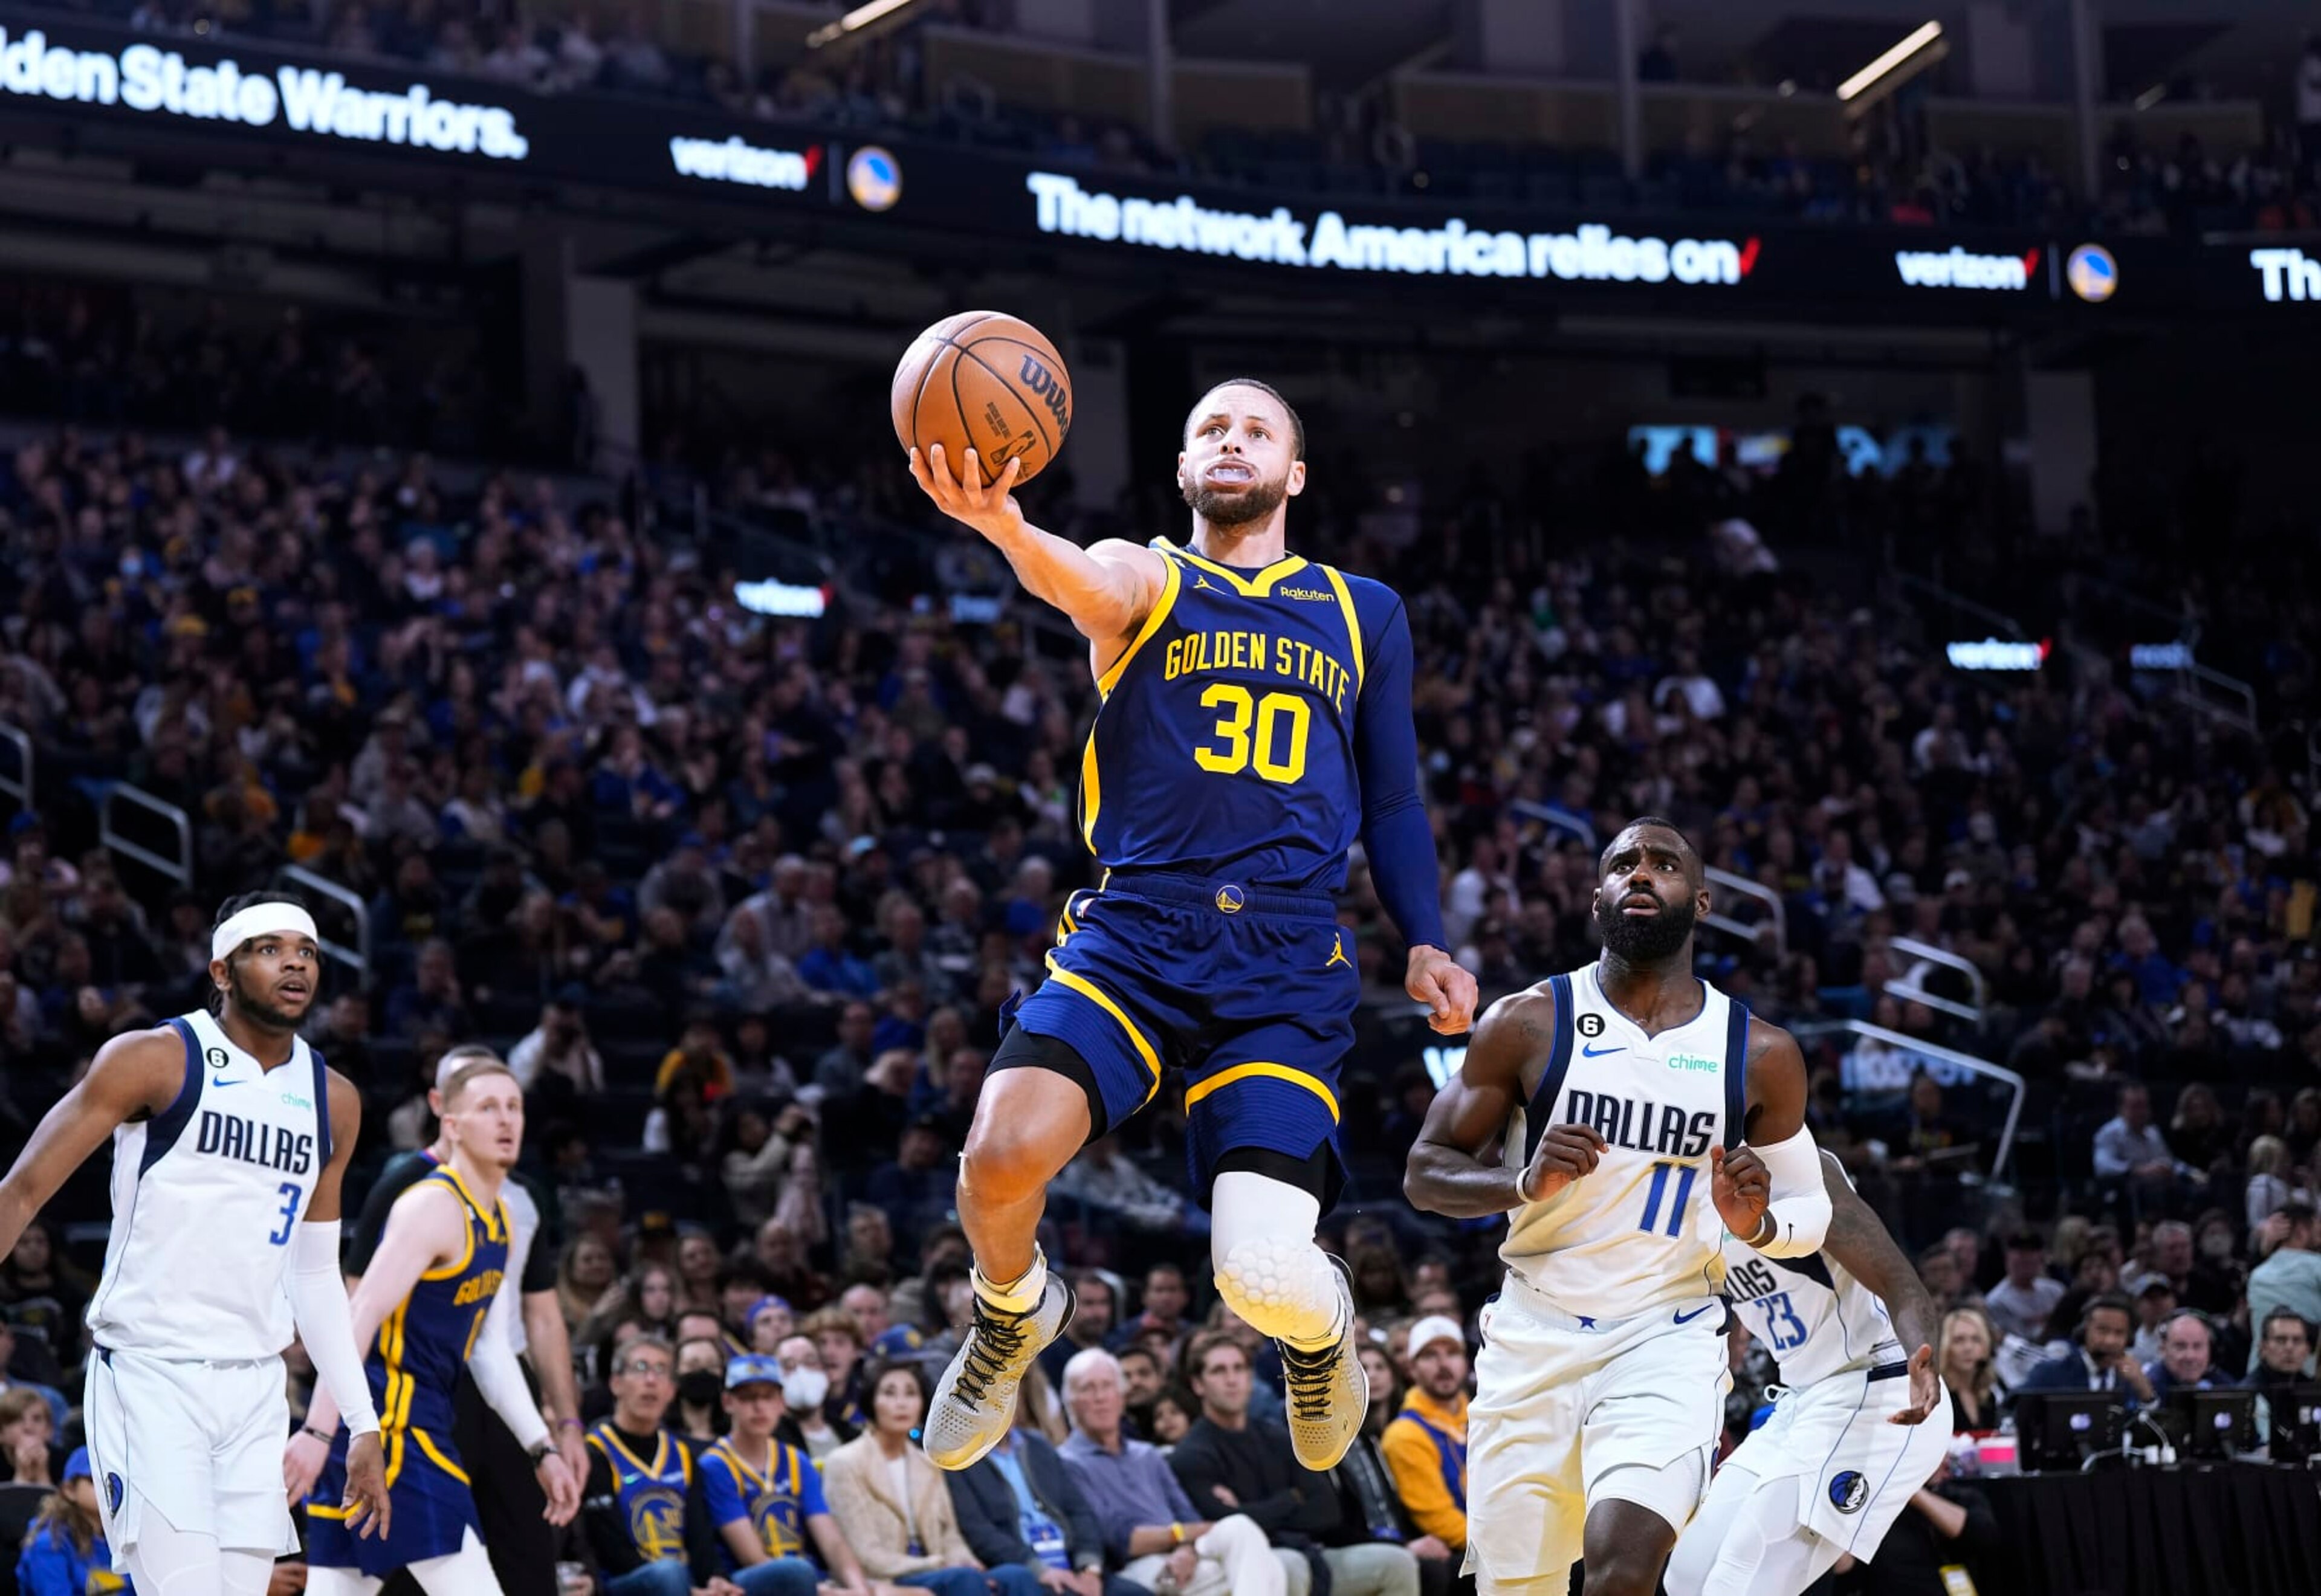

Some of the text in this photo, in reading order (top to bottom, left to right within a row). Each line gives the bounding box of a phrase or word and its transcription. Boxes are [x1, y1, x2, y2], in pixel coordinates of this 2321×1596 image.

[121, 44, 278, 126] State
[277, 65, 529, 160] Warriors.
[1027, 172, 1741, 285] The network America relies on
[1280, 586, 1335, 603] Rakuten
[1164, 632, 1350, 714] GOLDEN STATE
[1194, 683, 1310, 784] 30
[1583, 1017, 1599, 1035] 6
[1668, 1054, 1718, 1073] chime
[281, 1092, 311, 1111] chime
[1567, 1090, 1716, 1157] DALLAS
[196, 1111, 313, 1175] DALLAS
[269, 1182, 302, 1246] 3
[1638, 1161, 1699, 1239] 11
[1754, 1291, 1807, 1350] 23
